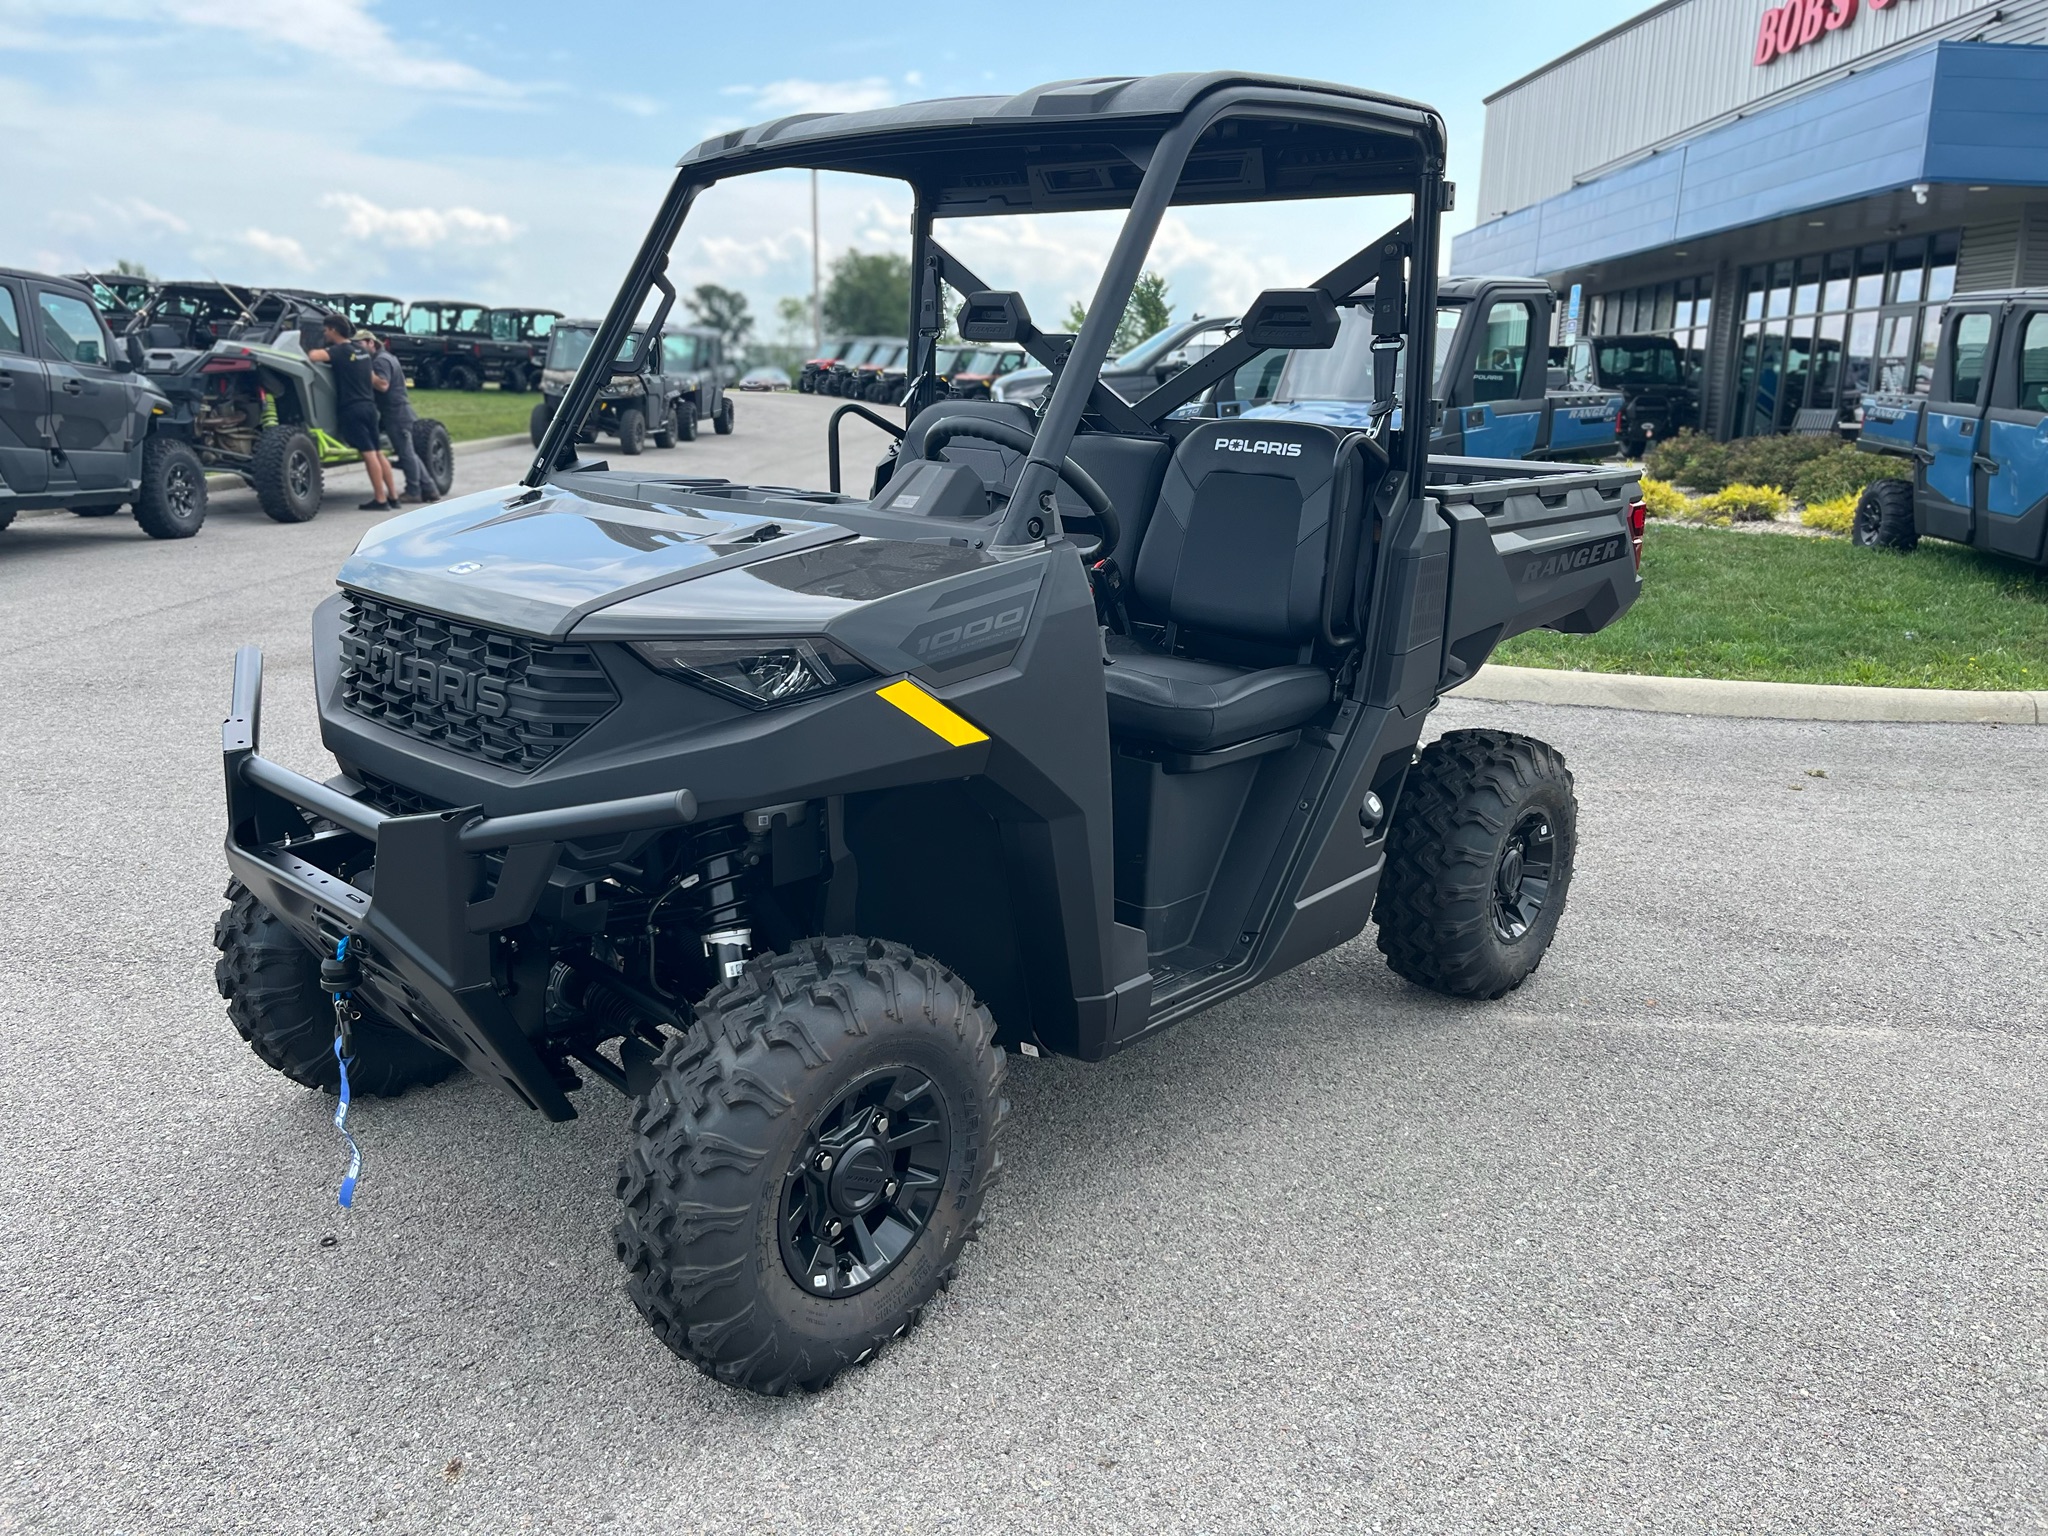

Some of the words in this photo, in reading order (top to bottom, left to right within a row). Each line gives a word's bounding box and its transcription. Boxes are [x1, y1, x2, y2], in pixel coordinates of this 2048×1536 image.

[1568, 406, 1615, 419] RANGER
[1867, 407, 1906, 420] RANGER
[1214, 438, 1302, 457] POLARIS
[1521, 540, 1619, 583] RANGER
[917, 606, 1025, 655] 1000
[349, 636, 511, 718] POLARIS
